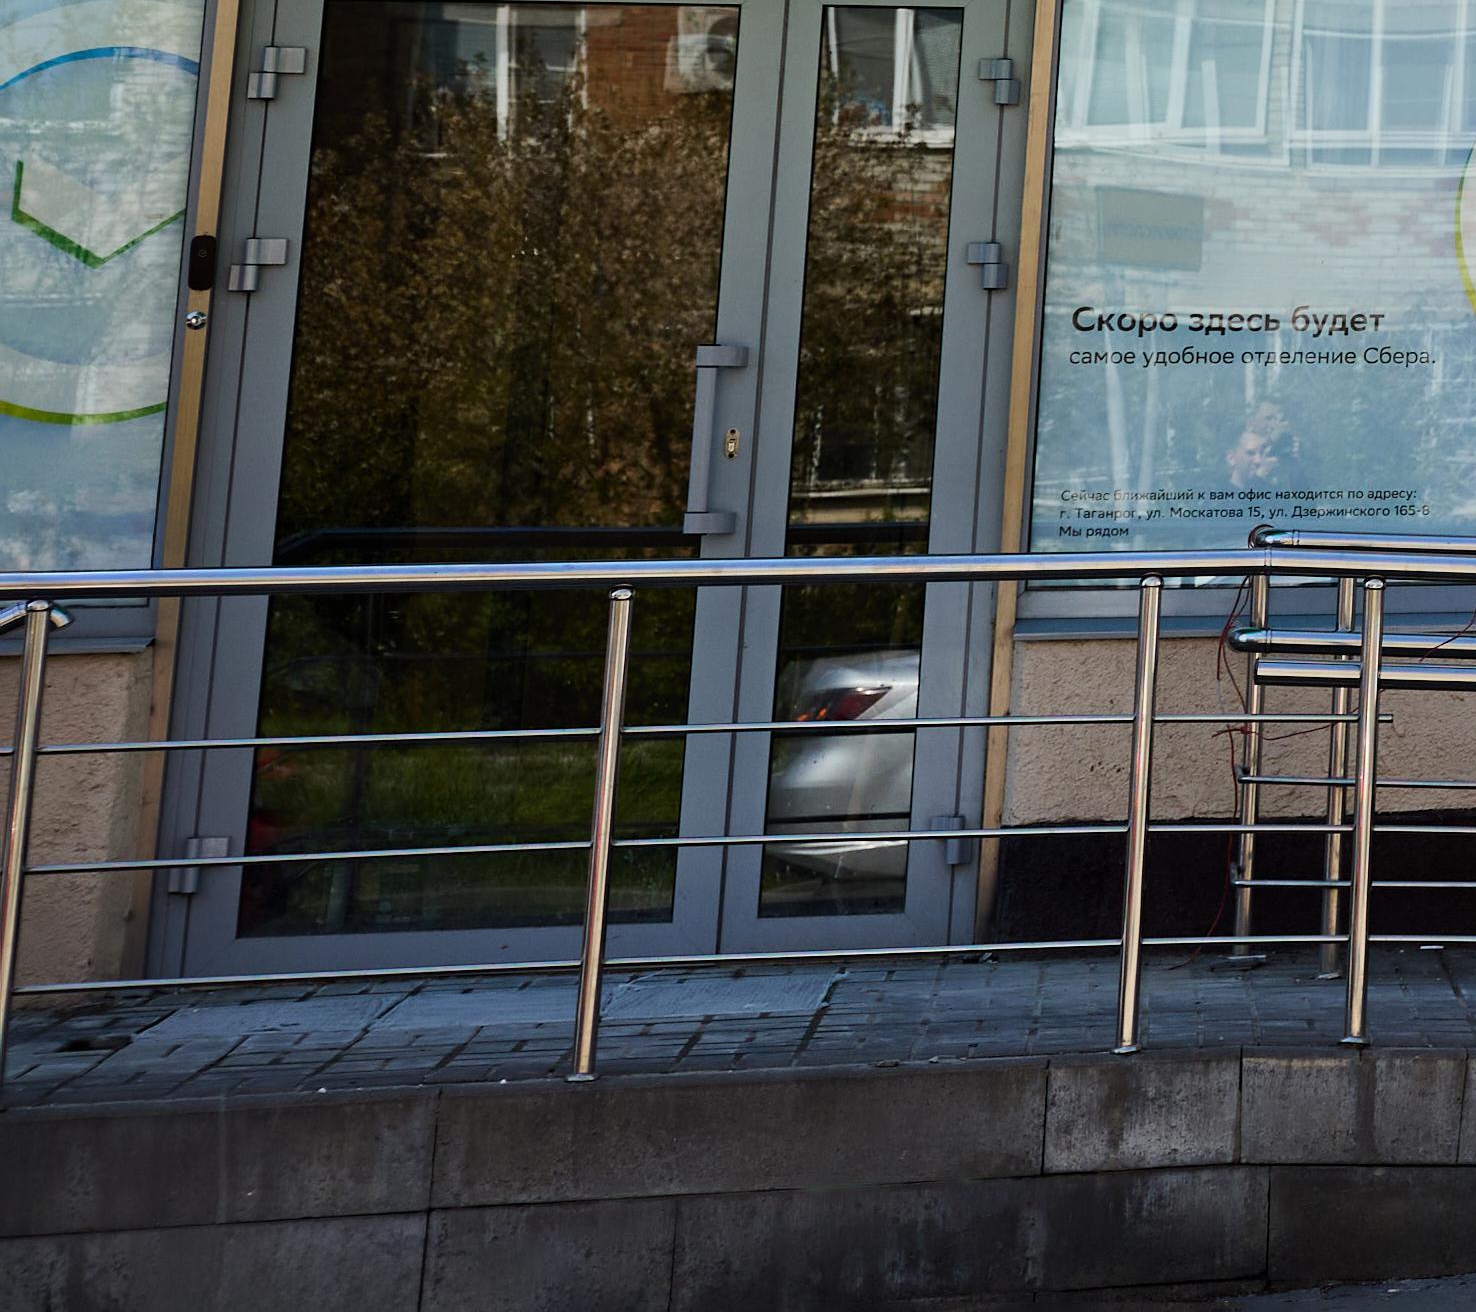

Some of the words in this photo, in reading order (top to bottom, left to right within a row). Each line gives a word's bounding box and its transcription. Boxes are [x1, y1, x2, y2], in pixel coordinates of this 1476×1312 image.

[1072, 306, 1178, 337] Скоро
[1189, 312, 1280, 336] здесь
[1292, 306, 1385, 337] будет
[1070, 351, 1135, 364] самое
[1143, 346, 1234, 367] удобное
[1242, 350, 1356, 367] отделение
[1364, 346, 1435, 368] Сбера.
[1061, 489, 1110, 501] Сейчас
[1113, 489, 1194, 501] ближайший
[1198, 492, 1205, 500] к
[1209, 491, 1233, 500] вам
[1238, 489, 1271, 501] офис
[1275, 491, 1343, 501] находится
[1348, 490, 1363, 499] по
[1368, 490, 1417, 502] адресу:
[1059, 510, 1070, 519] г.
[1076, 507, 1142, 522] Таганрог,
[1145, 510, 1165, 521] ул.
[1170, 507, 1243, 518] Москатова
[1249, 506, 1265, 519] 15,
[1269, 509, 1287, 519] ул.
[1291, 506, 1391, 519] Дзержинского
[1058, 526, 1082, 537] Мы
[1085, 528, 1129, 539] рядом
